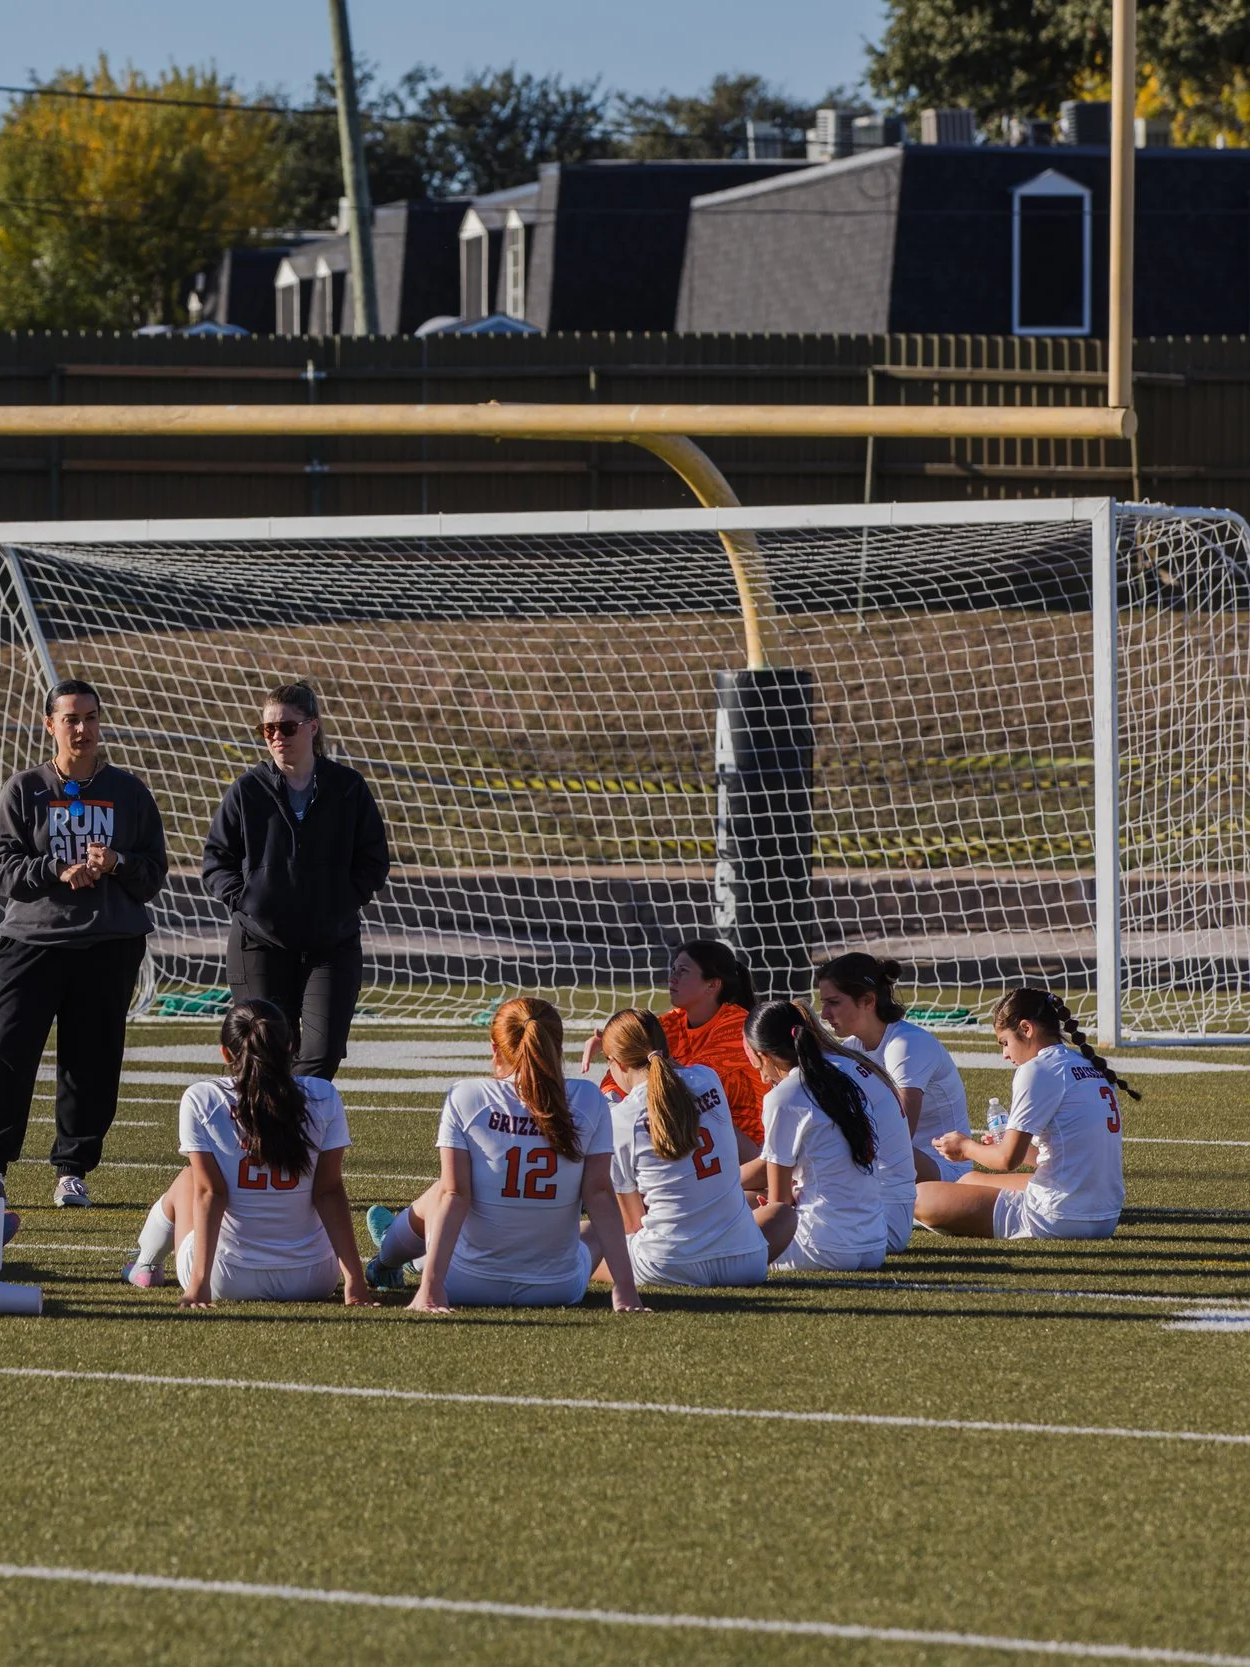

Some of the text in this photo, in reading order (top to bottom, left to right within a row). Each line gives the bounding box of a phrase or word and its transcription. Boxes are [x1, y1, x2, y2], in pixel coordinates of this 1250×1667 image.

[49, 806, 114, 836] RUN
[50, 835, 113, 865] GLE
[488, 1111, 546, 1137] GRIZZ
[1099, 1086, 1121, 1133] 3
[692, 1126, 722, 1180] 2
[501, 1146, 558, 1200] 12
